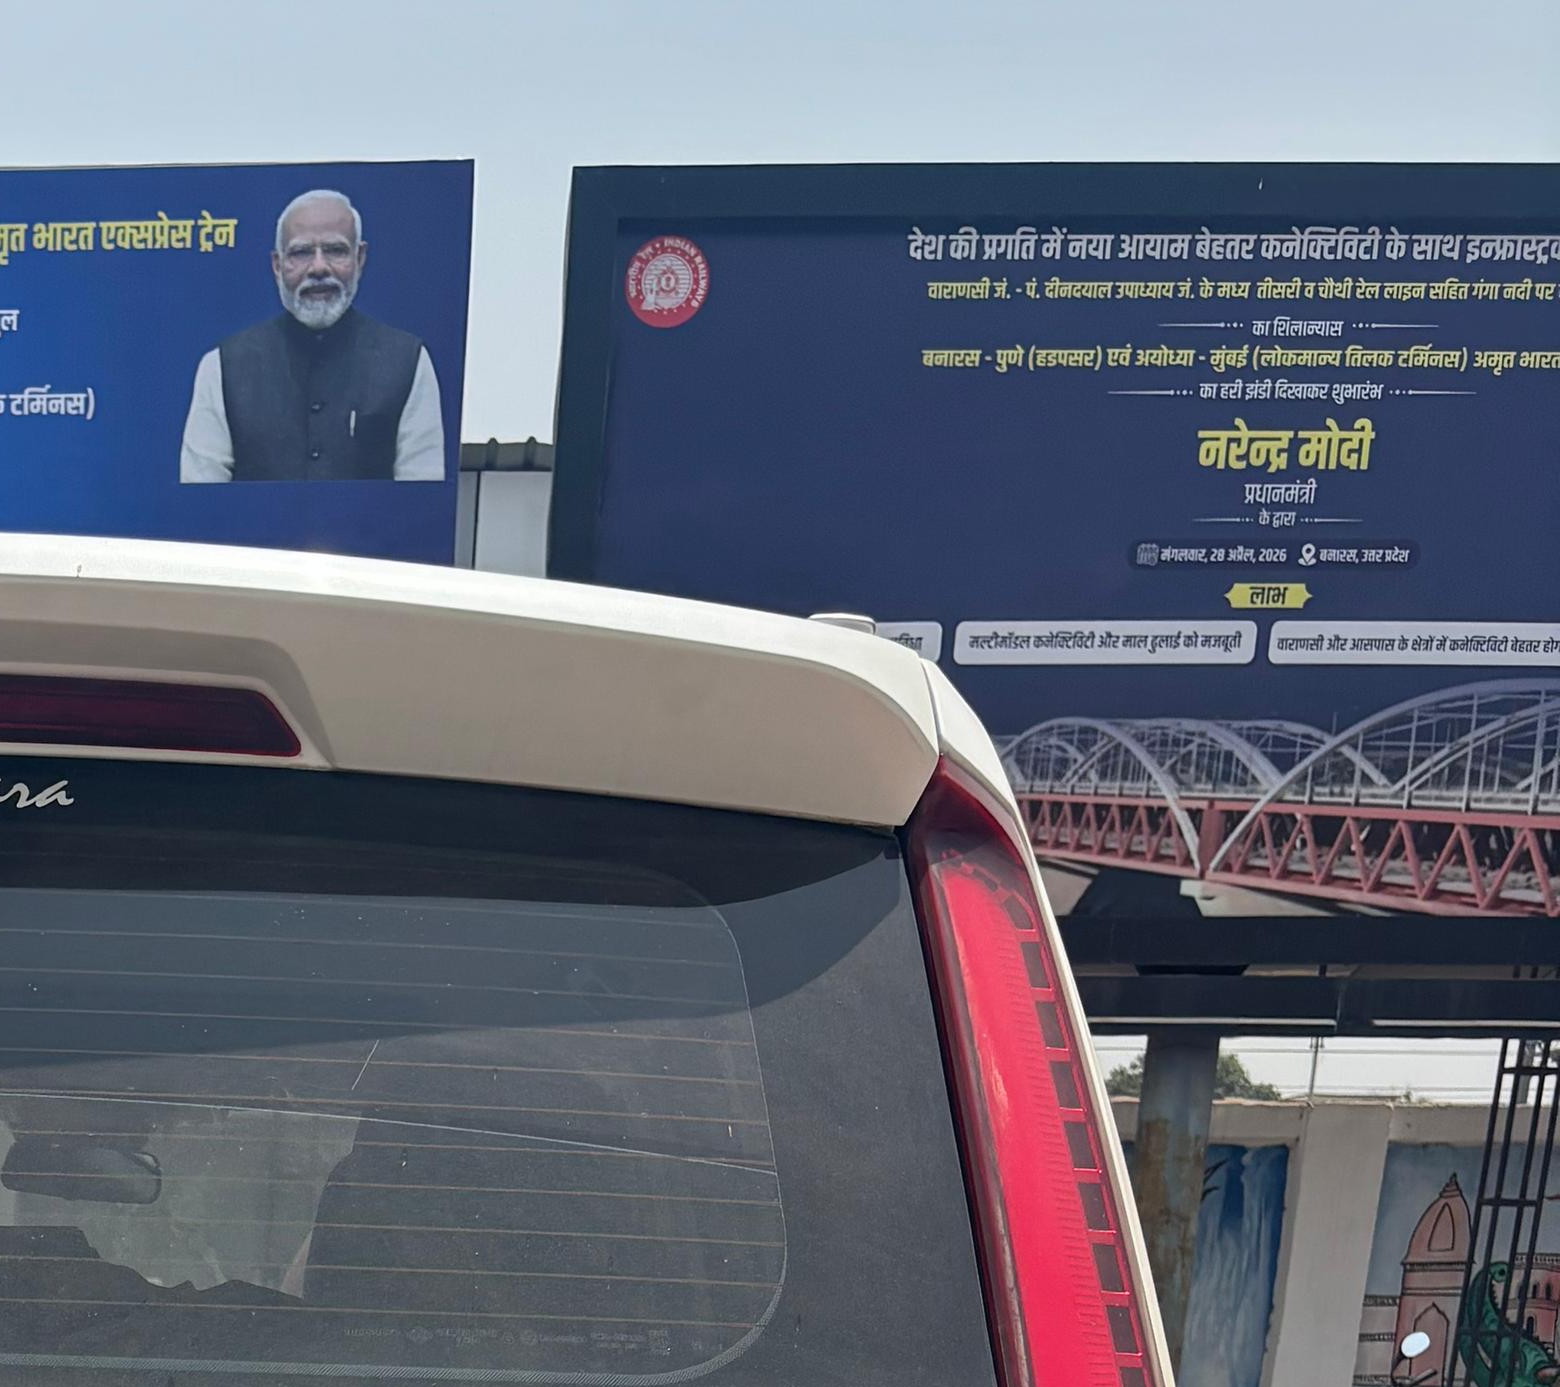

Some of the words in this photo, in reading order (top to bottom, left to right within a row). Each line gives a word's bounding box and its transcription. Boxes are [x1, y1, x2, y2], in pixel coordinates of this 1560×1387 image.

[33, 222, 96, 251] भारत
[99, 211, 195, 250] एक्सप्रेस
[197, 211, 237, 252] ट्रेन
[908, 227, 946, 260] देश
[949, 227, 979, 260] की
[982, 227, 1038, 260] प्रगति
[1041, 227, 1067, 259] में
[1068, 235, 1114, 259] नया
[1119, 235, 1192, 259] आयाम
[1195, 227, 1257, 259] बेहतर
[1260, 226, 1382, 259] कनेक्टिविटी
[1385, 227, 1409, 260] के
[1412, 235, 1463, 260] साथ
[928, 277, 990, 299] वाराणसी
[993, 278, 1010, 298] जं.
[1026, 278, 1040, 298] पं.
[1044, 277, 1113, 298] दीनदयाल
[1115, 282, 1175, 298] उपाध्याय
[1177, 278, 1194, 298] जं.
[1199, 277, 1215, 298] के
[1217, 282, 1251, 298] मध्य
[1257, 277, 1302, 298] तीसरी
[1304, 283, 1316, 298] व
[1318, 277, 1353, 298] चौथी
[1356, 278, 1382, 298] रेल
[1384, 283, 1427, 301] लाइन
[1429, 278, 1470, 299] सहित
[1472, 279, 1501, 299] गंगा
[1503, 278, 1533, 300] नदी
[1535, 284, 1556, 300] पर
[1253, 321, 1271, 336] का
[1273, 316, 1344, 336] शिलान्यास
[922, 350, 982, 366] बनारस
[995, 345, 1024, 372] पुणे
[1029, 346, 1102, 370] (हडपसर)
[1107, 344, 1132, 366] एवं
[1135, 345, 1195, 366] अयोध्या
[1210, 345, 1249, 372] मुंबई
[1253, 345, 1342, 370] (लोकमान्य
[1345, 345, 1395, 367] तिलक
[1397, 344, 1467, 371] टर्मिनस)
[1473, 351, 1516, 375] अमृत
[9, 385, 94, 419] टर्मिनस)
[1200, 384, 1218, 398] का
[1220, 379, 1243, 398] हरी
[1245, 379, 1272, 400] झंडी
[1275, 379, 1329, 399] दिखाकर
[1332, 381, 1384, 404] शुभारंभ
[1198, 418, 1294, 472] नरेन्द्र
[1298, 418, 1375, 469] मोदी
[1245, 478, 1317, 503] प्रधानमंत्री
[1259, 508, 1271, 524] के
[1273, 512, 1296, 527] द्वारा
[1250, 587, 1288, 604] लाभ
